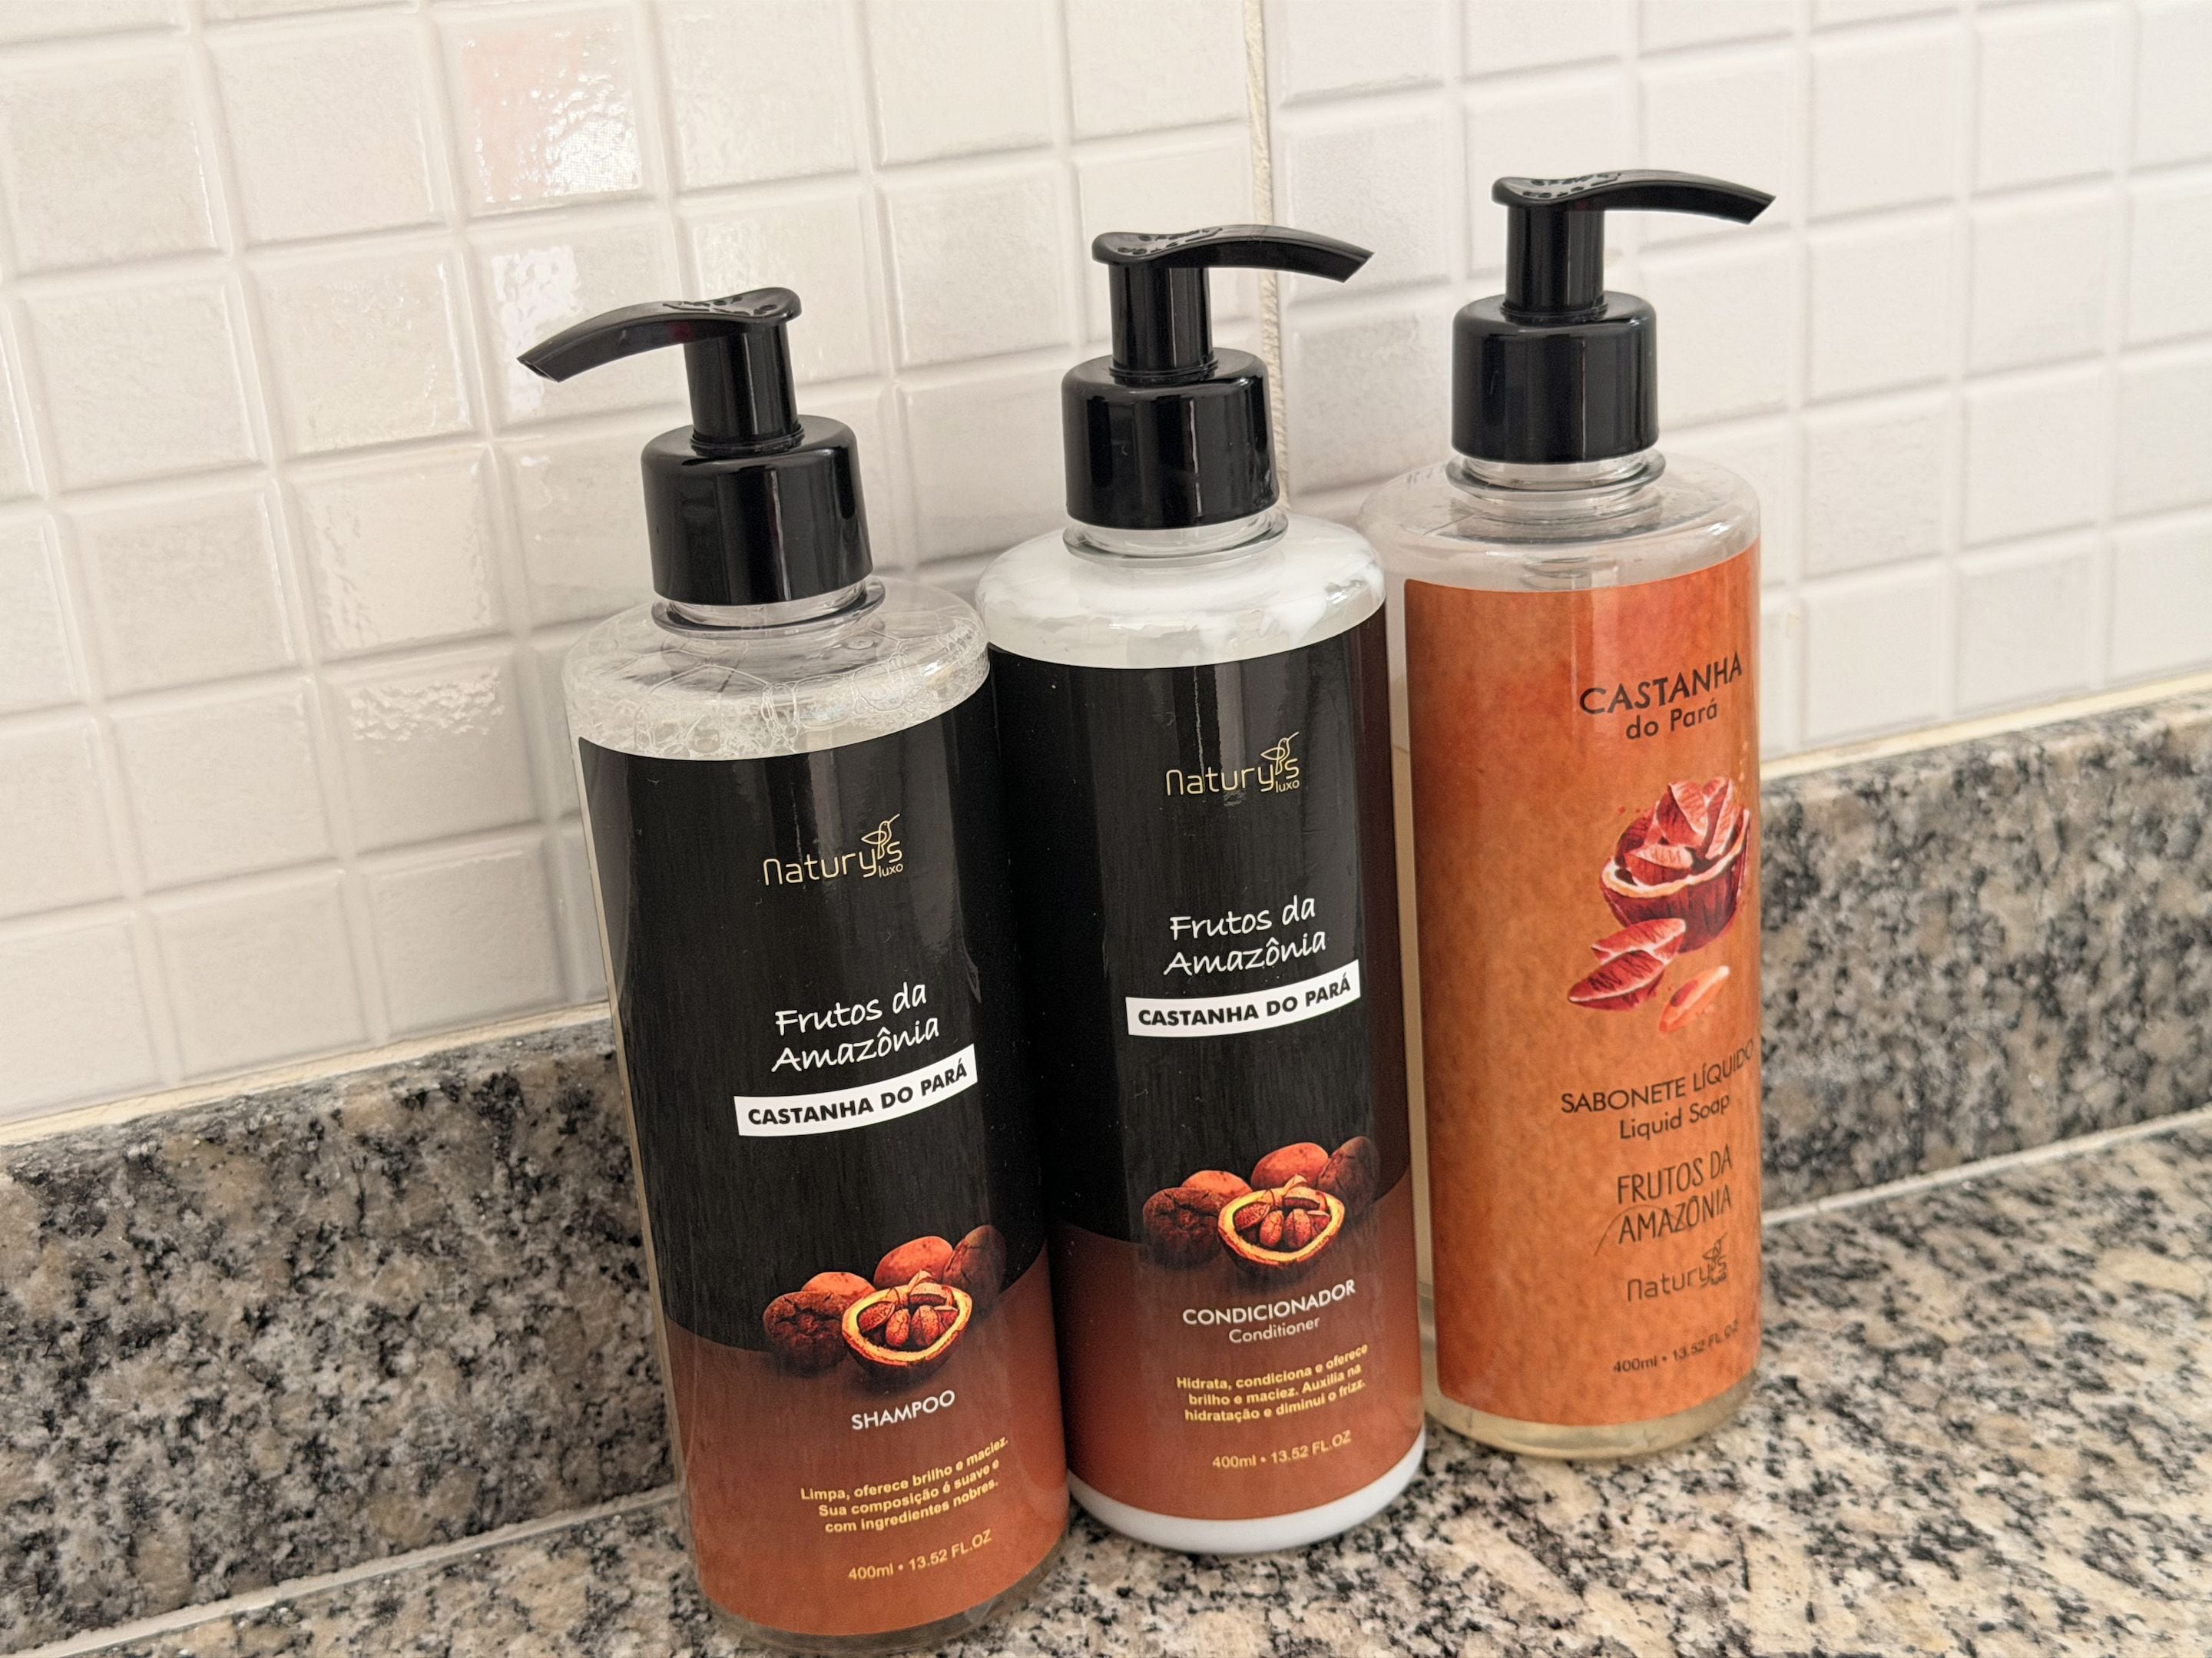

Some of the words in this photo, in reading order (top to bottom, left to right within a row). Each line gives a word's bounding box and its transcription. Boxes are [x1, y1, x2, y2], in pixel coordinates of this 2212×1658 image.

[1579, 651, 1742, 715] CASTANHA
[1626, 715, 1659, 740] do
[1670, 697, 1717, 732] Pará
[1275, 779, 1300, 793] luxo
[878, 862, 904, 878] luxo
[1170, 908, 1272, 941] Frutos
[1282, 895, 1316, 925] da
[1163, 931, 1326, 976] Amazônia
[774, 999, 882, 1036] Frutos
[892, 981, 927, 1009] da
[1138, 1004, 1259, 1026] CASTANHA
[1267, 995, 1298, 1017] DO
[1305, 973, 1351, 1008] PARÁ
[771, 1017, 939, 1072] Amazônia
[748, 1097, 873, 1125] CASTANHA
[881, 1086, 912, 1109] DO
[921, 1057, 967, 1097] PARÁ
[1561, 1076, 1687, 1114] SABONETE
[1693, 1037, 1754, 1092] LÍQUIDO
[1620, 1107, 1682, 1140] Liquid
[1689, 1094, 1730, 1124] Soap
[1618, 1157, 1704, 1205] FRUTOS
[1710, 1143, 1733, 1180] DA
[1618, 1183, 1733, 1245] AMAZÔNIA
[1182, 1279, 1356, 1325] CONDICIONADOR
[1229, 1317, 1320, 1343] Conditioner
[1177, 1377, 1232, 1391] Hidrata,
[1235, 1366, 1313, 1388] condiciona
[1315, 1364, 1323, 1373] e
[1326, 1344, 1368, 1370] oferece
[1188, 1393, 1230, 1406] brilho
[1233, 1396, 1243, 1405] e
[1246, 1387, 1299, 1404] maciez.
[1302, 1372, 1345, 1394] Auxilia
[1347, 1364, 1362, 1378] na
[1613, 1355, 1657, 1372] 400ml
[851, 1389, 955, 1430] SHAMPOO
[1184, 1408, 1260, 1423] hidratação
[1263, 1408, 1272, 1418] e
[1276, 1393, 1326, 1416] diminui
[1328, 1392, 1336, 1402] o
[800, 1488, 850, 1502] Limpa,
[853, 1480, 909, 1497] oferece
[912, 1465, 952, 1488] brilho
[955, 1461, 963, 1471] e
[966, 1436, 1008, 1466] maciez.
[1212, 1454, 1257, 1468] 400ml
[1270, 1445, 1309, 1464] 13.52
[1312, 1429, 1352, 1454] FL.OZ
[819, 1504, 847, 1517] Sua
[851, 1486, 939, 1514] composição
[942, 1481, 951, 1494] é
[954, 1464, 990, 1489] suave
[992, 1459, 999, 1470] e
[825, 1522, 857, 1533] com
[861, 1501, 949, 1531] ingredientes
[952, 1479, 998, 1507] nobres.
[848, 1564, 894, 1581] 400ml
[909, 1549, 948, 1572] 13.52
[951, 1528, 992, 1558] FL.OZ
